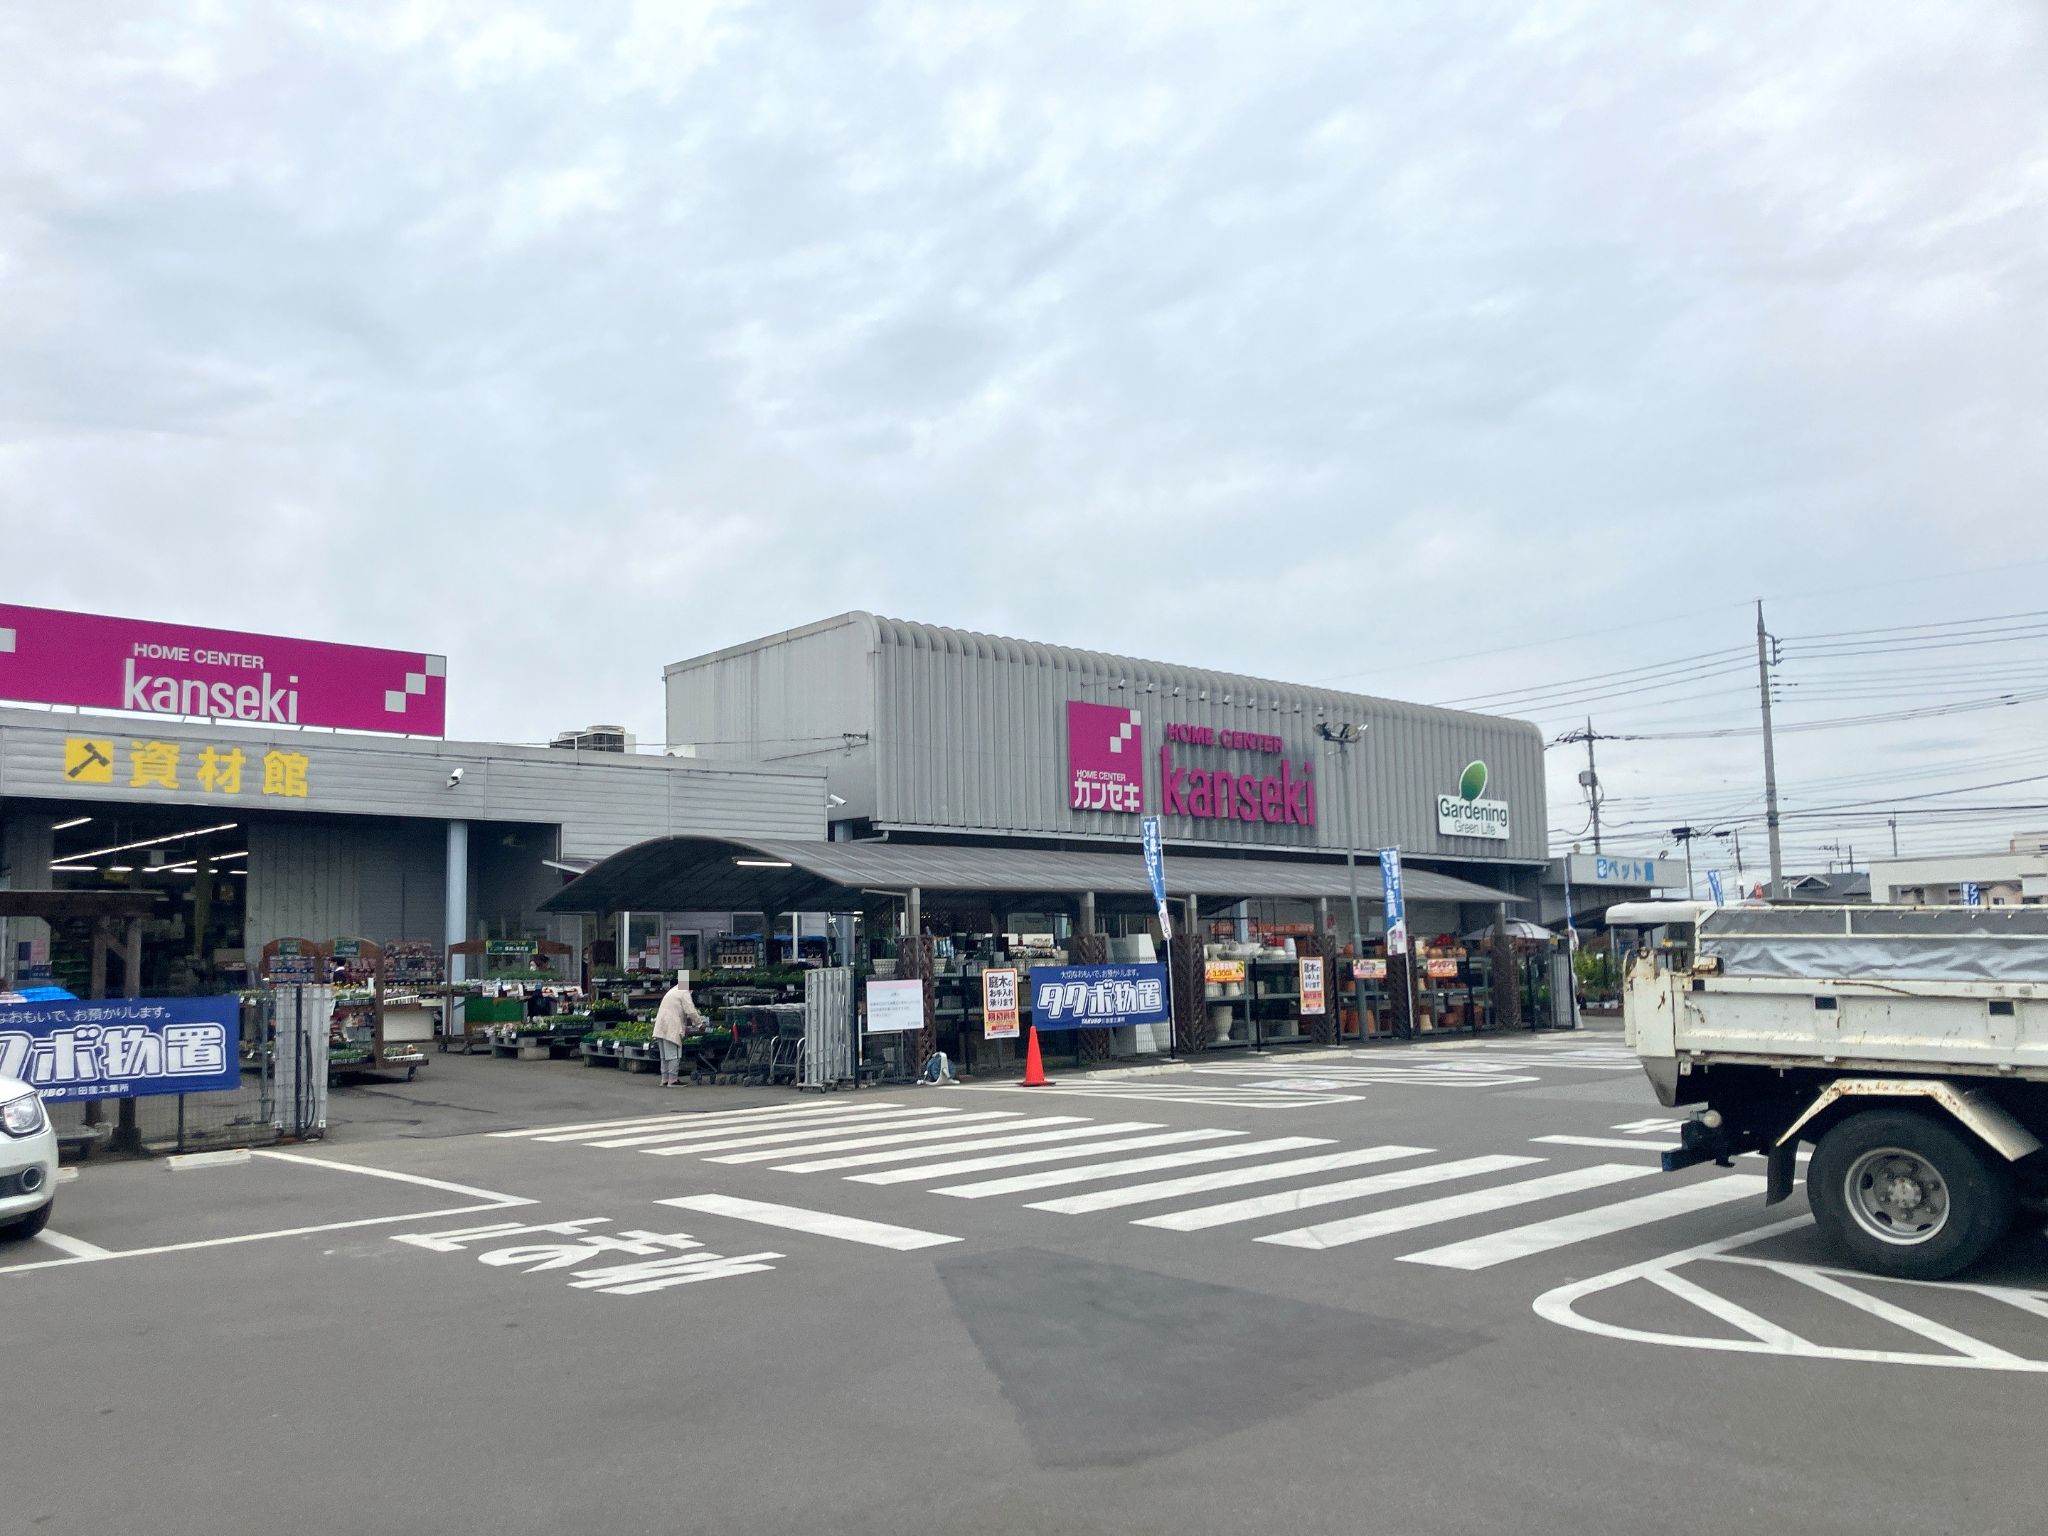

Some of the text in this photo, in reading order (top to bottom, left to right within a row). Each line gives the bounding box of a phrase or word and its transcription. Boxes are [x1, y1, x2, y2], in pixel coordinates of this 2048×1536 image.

[134, 642, 265, 669] HOME CENTER
[124, 657, 298, 723] kanseki
[1167, 722, 1284, 753] HOME CENTER
[129, 740, 310, 797] 資材館
[1076, 769, 1126, 782] HOME CENTER
[1161, 745, 1315, 826] kanseki
[1074, 778, 1140, 812] カンセキ
[1440, 798, 1508, 827] Gardening
[1454, 820, 1496, 835] Green Life
[1037, 978, 1162, 1019] タクボ物置
[389, 1216, 786, 1295] 止まれ
